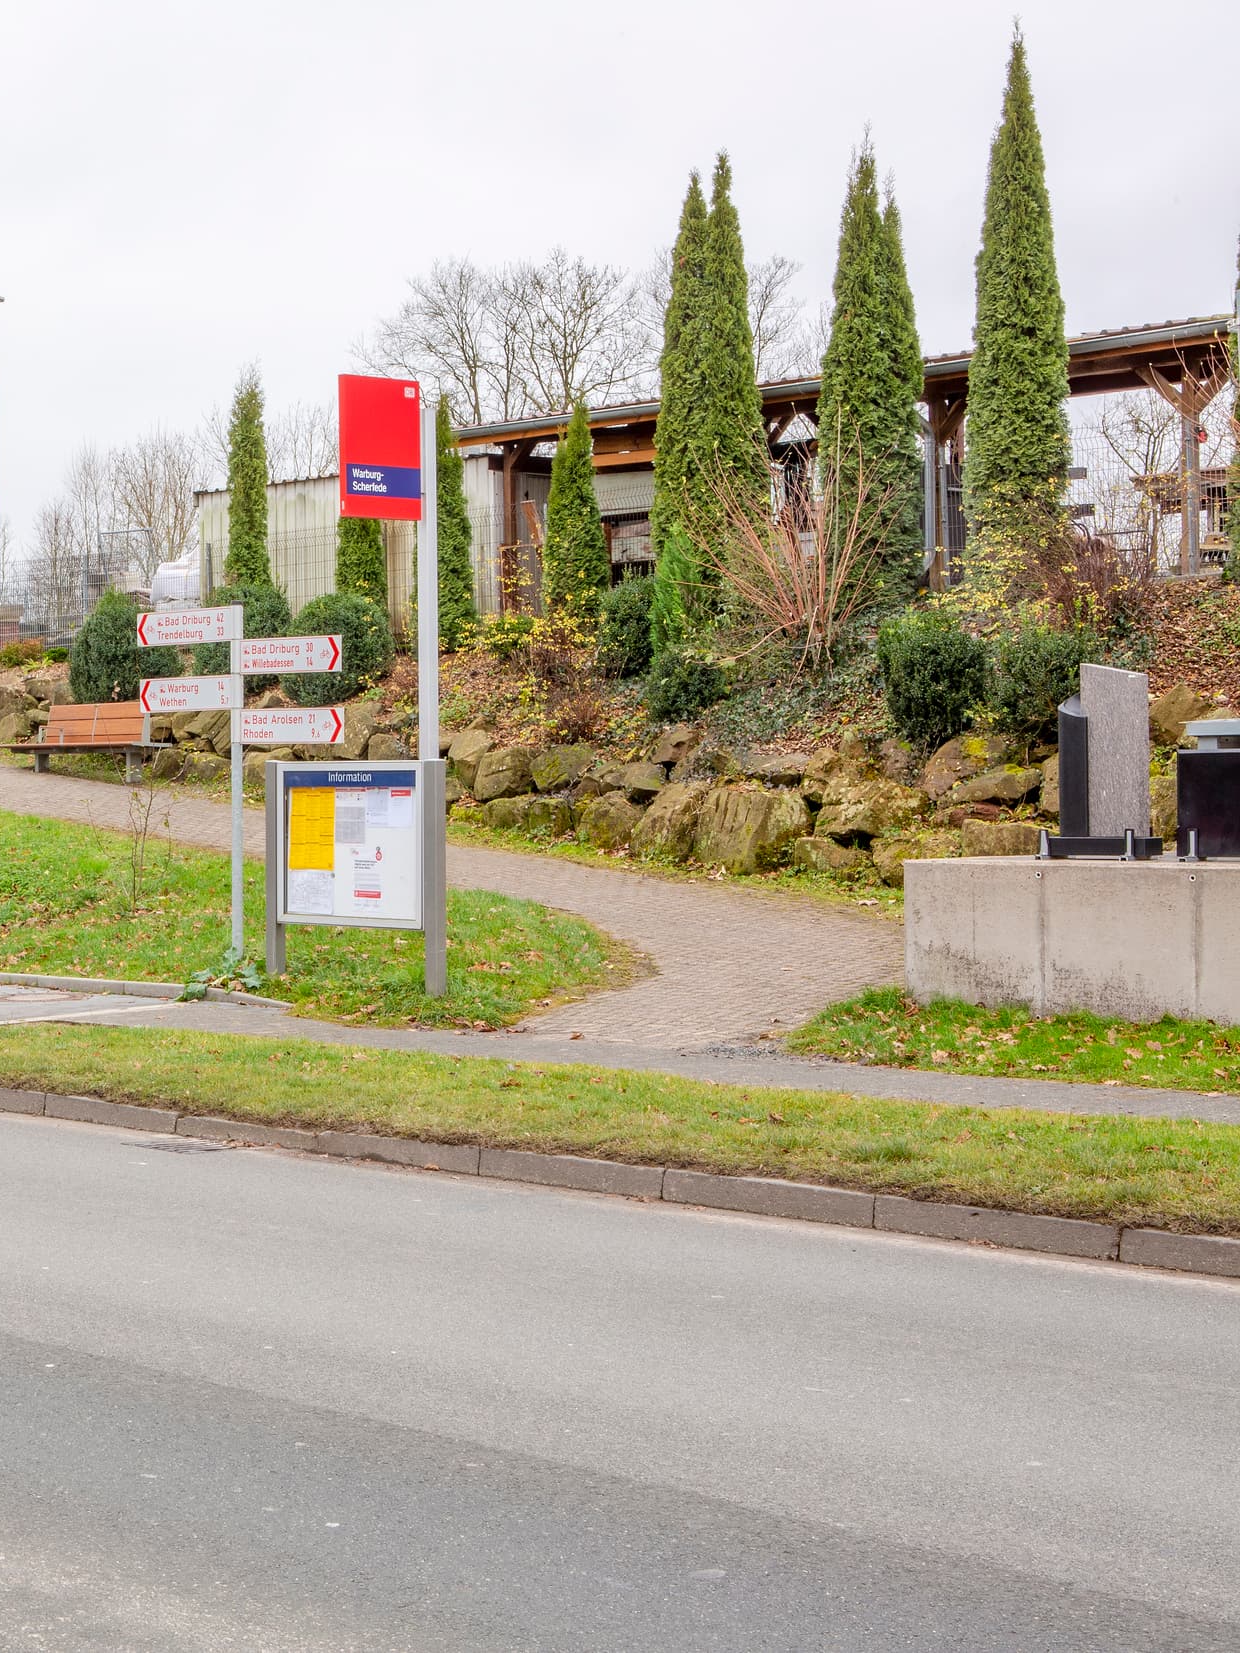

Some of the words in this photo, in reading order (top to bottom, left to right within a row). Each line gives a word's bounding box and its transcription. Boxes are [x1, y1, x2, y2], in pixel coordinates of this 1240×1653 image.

[352, 468, 384, 481] Warburg-
[352, 481, 387, 493] Scherfede
[165, 616, 179, 627] Bad
[182, 615, 211, 626] Driburg
[216, 612, 224, 623] 42
[157, 629, 203, 640] Trendelburg
[217, 626, 224, 637] 33
[251, 644, 266, 655] Bad
[270, 643, 300, 656] Driburg
[306, 642, 313, 653] 30
[252, 658, 294, 669] Willebadessen
[306, 656, 313, 667] 14
[167, 683, 199, 694] Warburg
[218, 681, 224, 692] 14
[160, 697, 187, 707] Wethen
[252, 714, 267, 724] Bad
[271, 714, 303, 724] Arolsen
[308, 713, 316, 724] 21
[243, 728, 274, 739] Rhoden
[328, 772, 372, 783] Information
